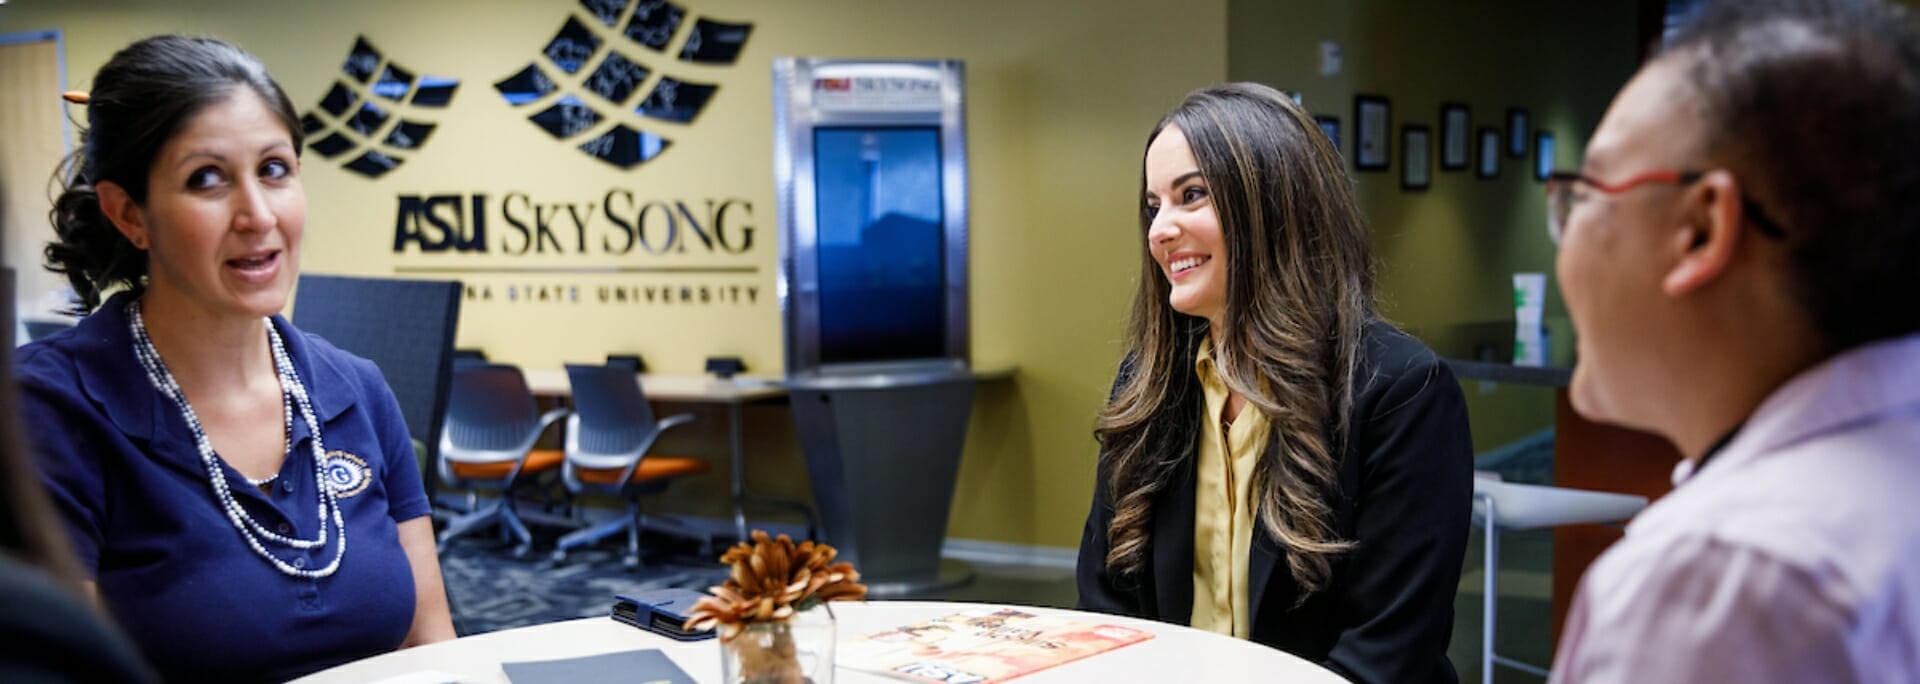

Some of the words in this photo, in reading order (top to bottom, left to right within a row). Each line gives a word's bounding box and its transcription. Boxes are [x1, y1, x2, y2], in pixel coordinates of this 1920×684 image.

[393, 194, 487, 252] ASU
[506, 286, 579, 302] STATE
[598, 286, 759, 303] UNIVERSITY
